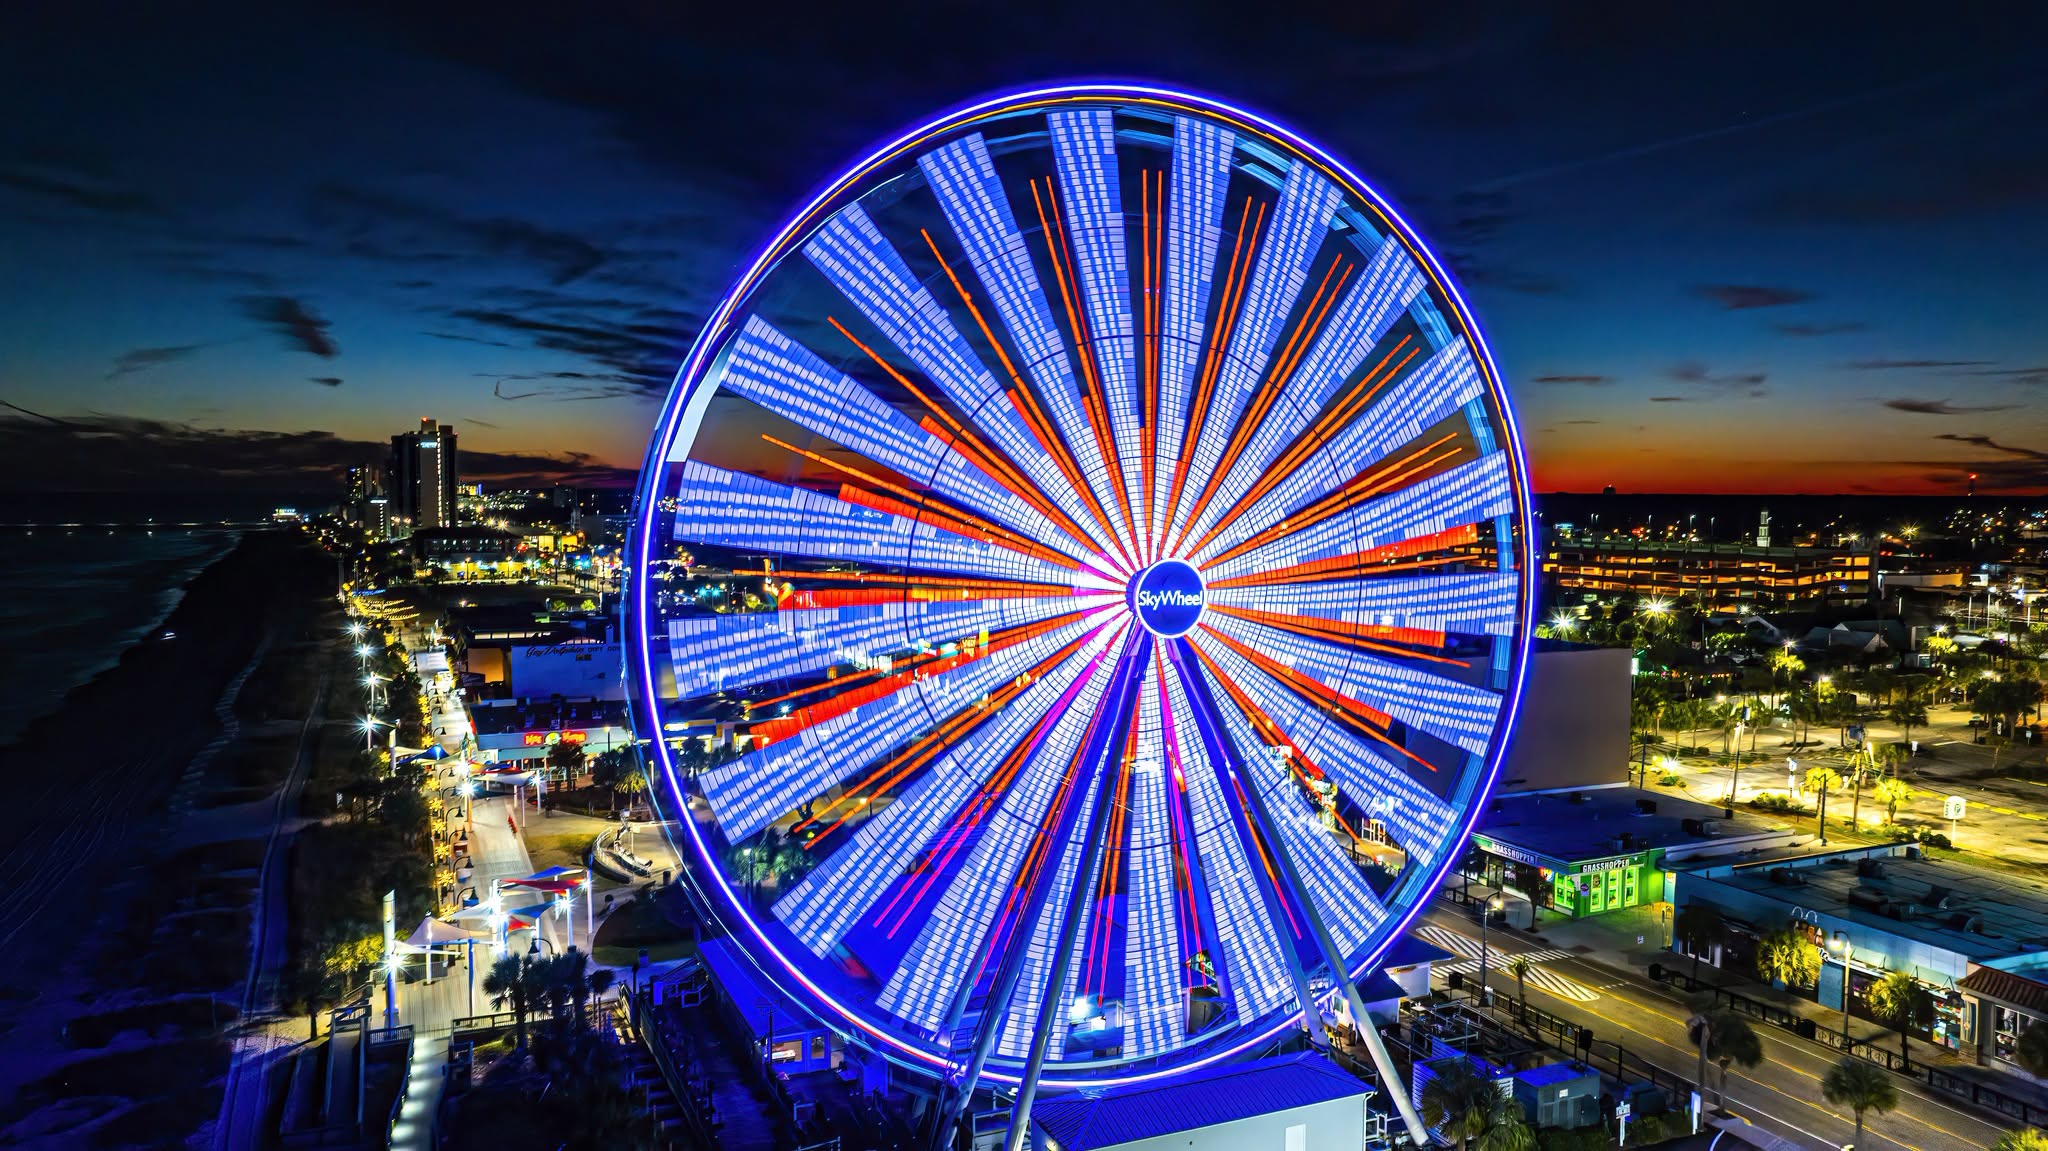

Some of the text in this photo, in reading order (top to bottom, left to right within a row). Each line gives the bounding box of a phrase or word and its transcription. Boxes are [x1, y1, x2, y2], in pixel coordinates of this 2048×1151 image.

[1138, 589, 1203, 611] SkyWheel
[1492, 842, 1535, 864] GRASSHOPPER
[1582, 858, 1630, 874] GRASSHOPPER
